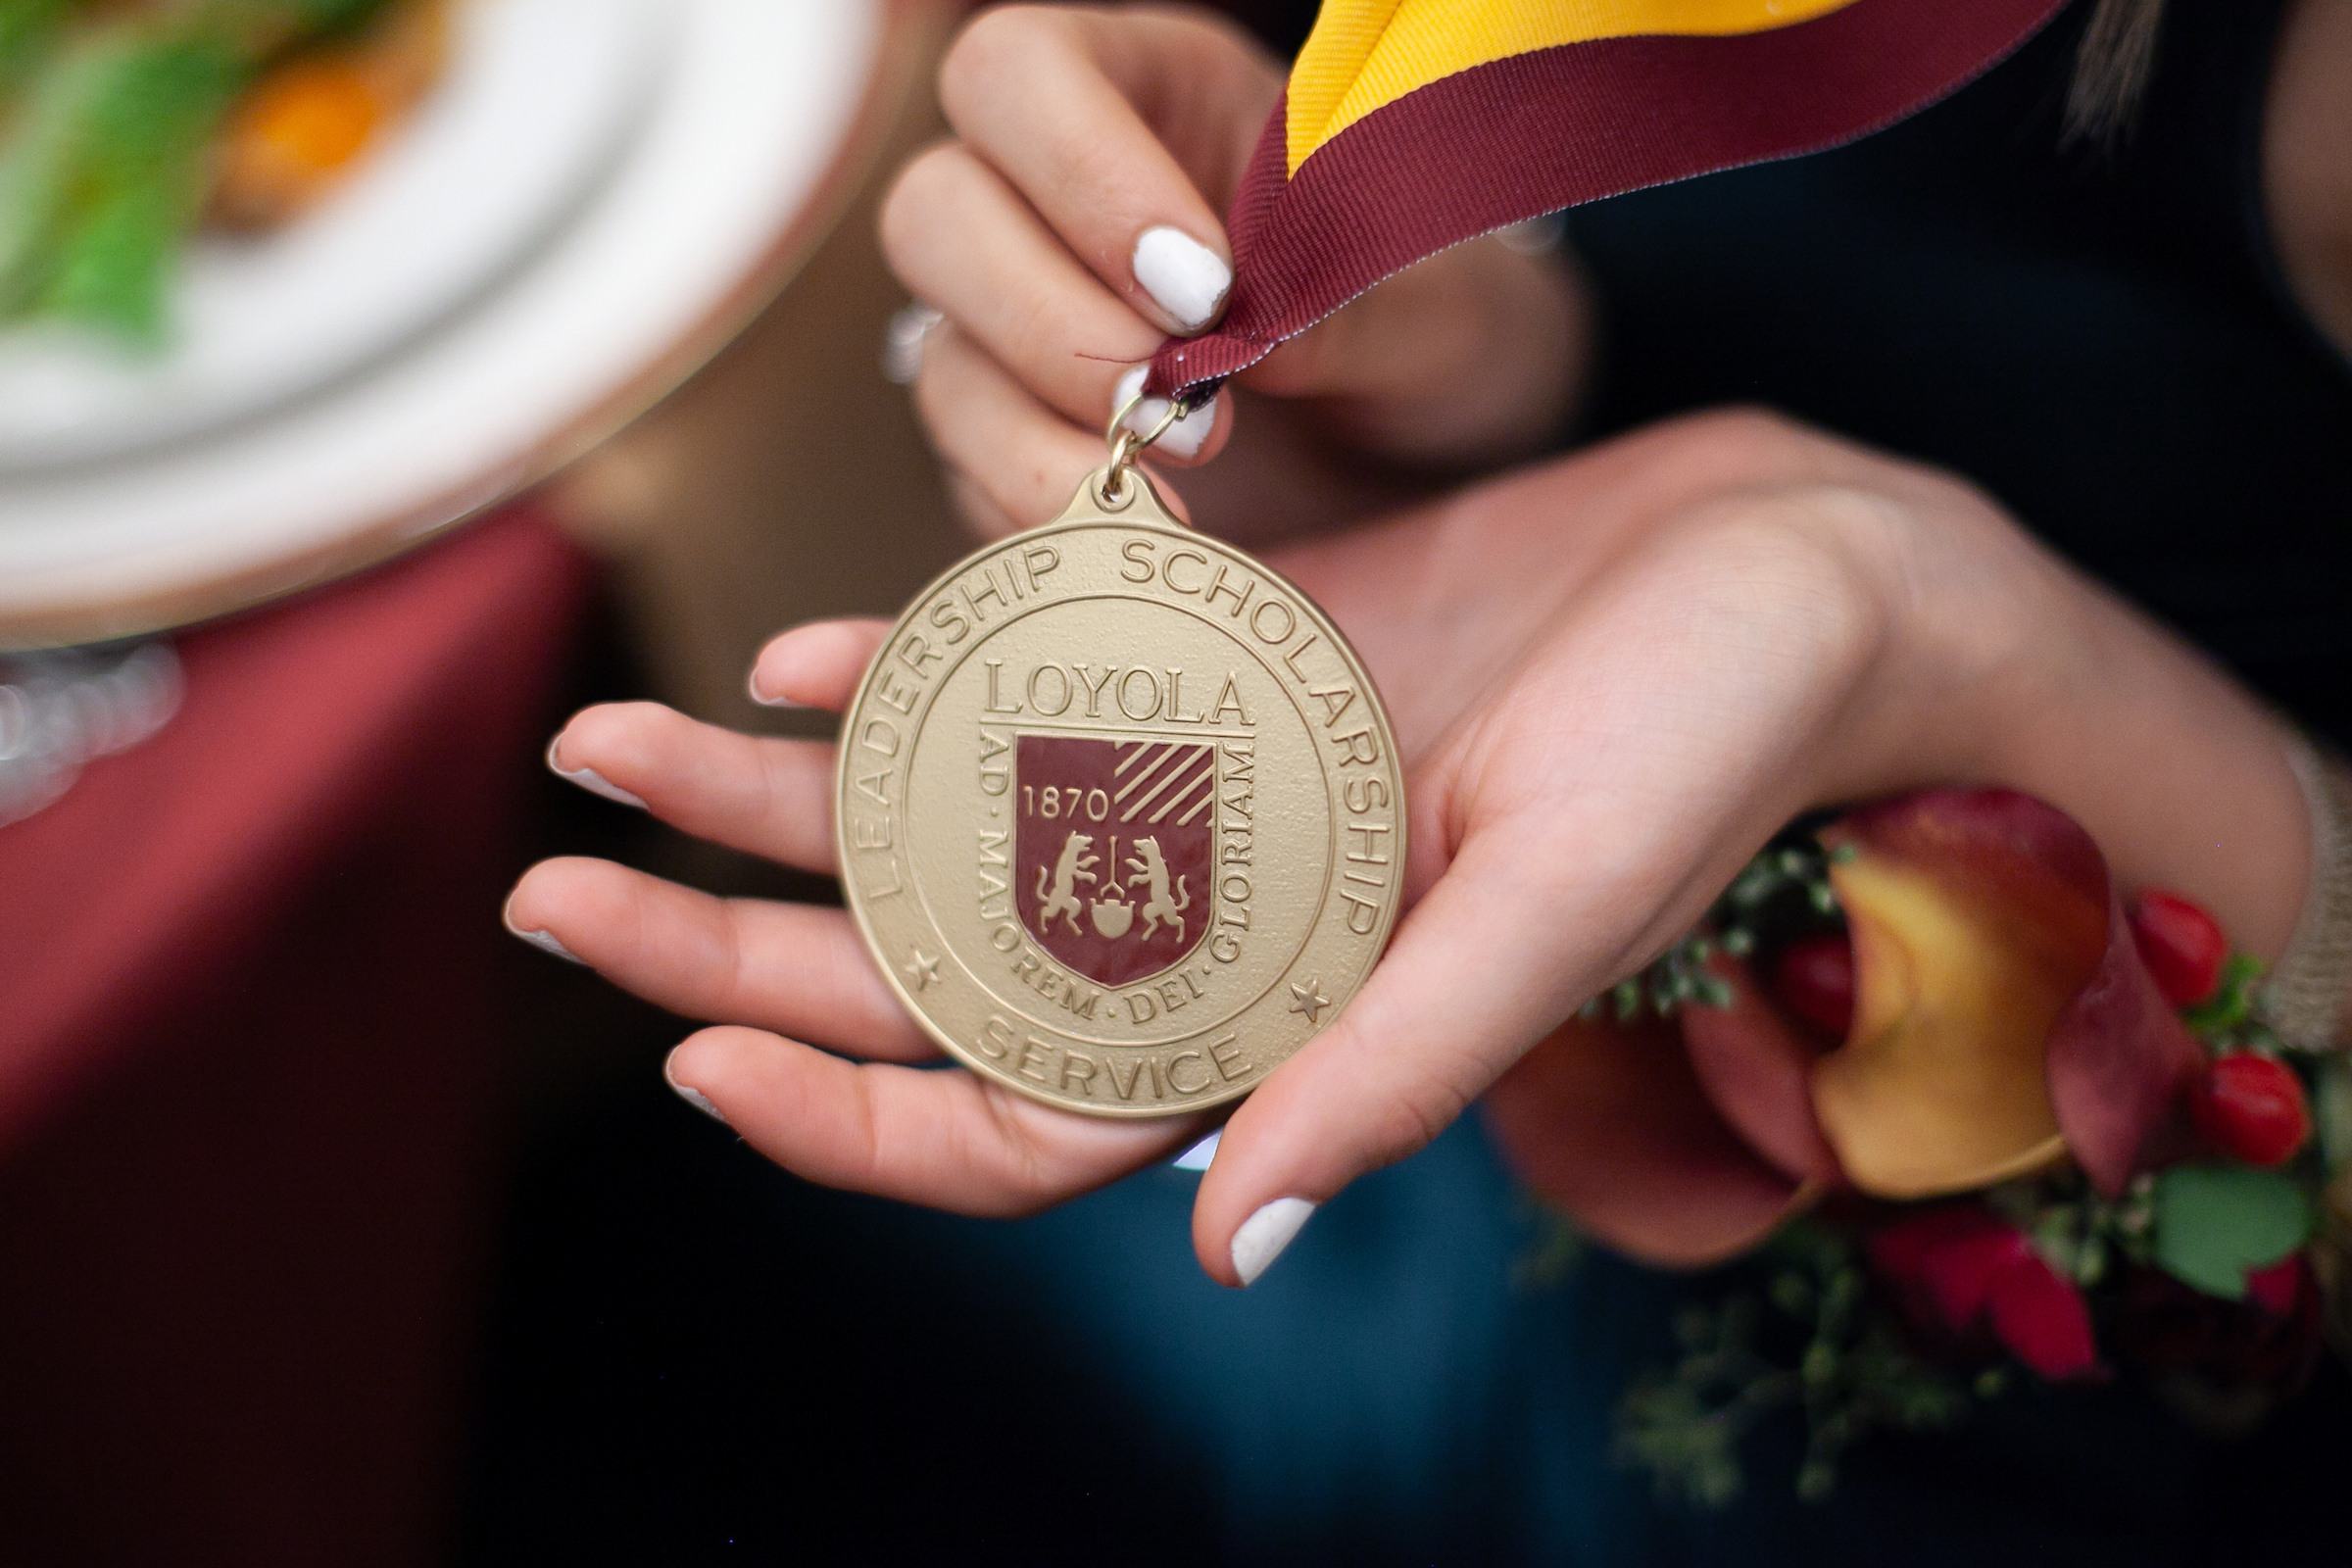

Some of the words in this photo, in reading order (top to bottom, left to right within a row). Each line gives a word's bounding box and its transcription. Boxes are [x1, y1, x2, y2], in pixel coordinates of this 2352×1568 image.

[984, 658, 1256, 726] LOYOLA
[854, 545, 1061, 901] LEADERSHIP
[1119, 538, 1391, 935] SCHOLARSHIP
[979, 728, 1010, 797] AD
[1022, 785, 1110, 823] 1870
[1208, 742, 1255, 964] GLORIAM
[979, 828, 1102, 1020] MAJOREM
[1123, 965, 1204, 1025] DEI
[976, 1014, 1254, 1102] SERVICE
